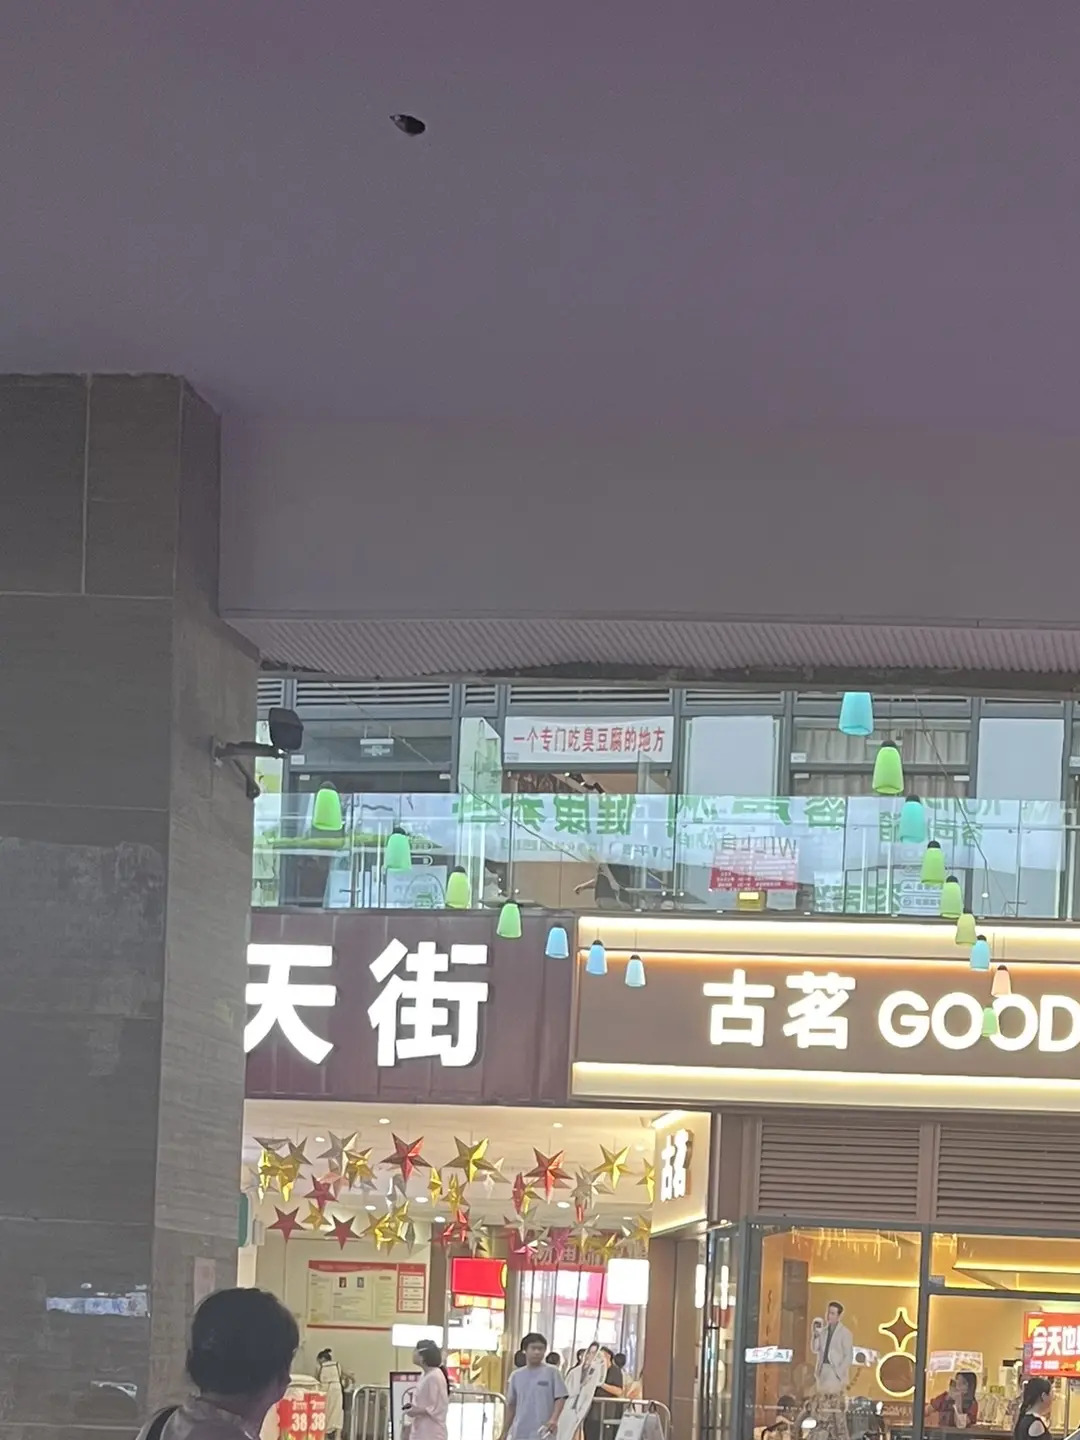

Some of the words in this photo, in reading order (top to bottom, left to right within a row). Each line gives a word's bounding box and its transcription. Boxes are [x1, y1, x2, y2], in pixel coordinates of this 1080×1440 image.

[513, 726, 665, 753] 一个专门吃臭豆腐的地方
[244, 938, 489, 1066] 天街
[703, 969, 856, 1049] 古茗
[292, 1412, 307, 1432] 38
[311, 1412, 326, 1432] 38
